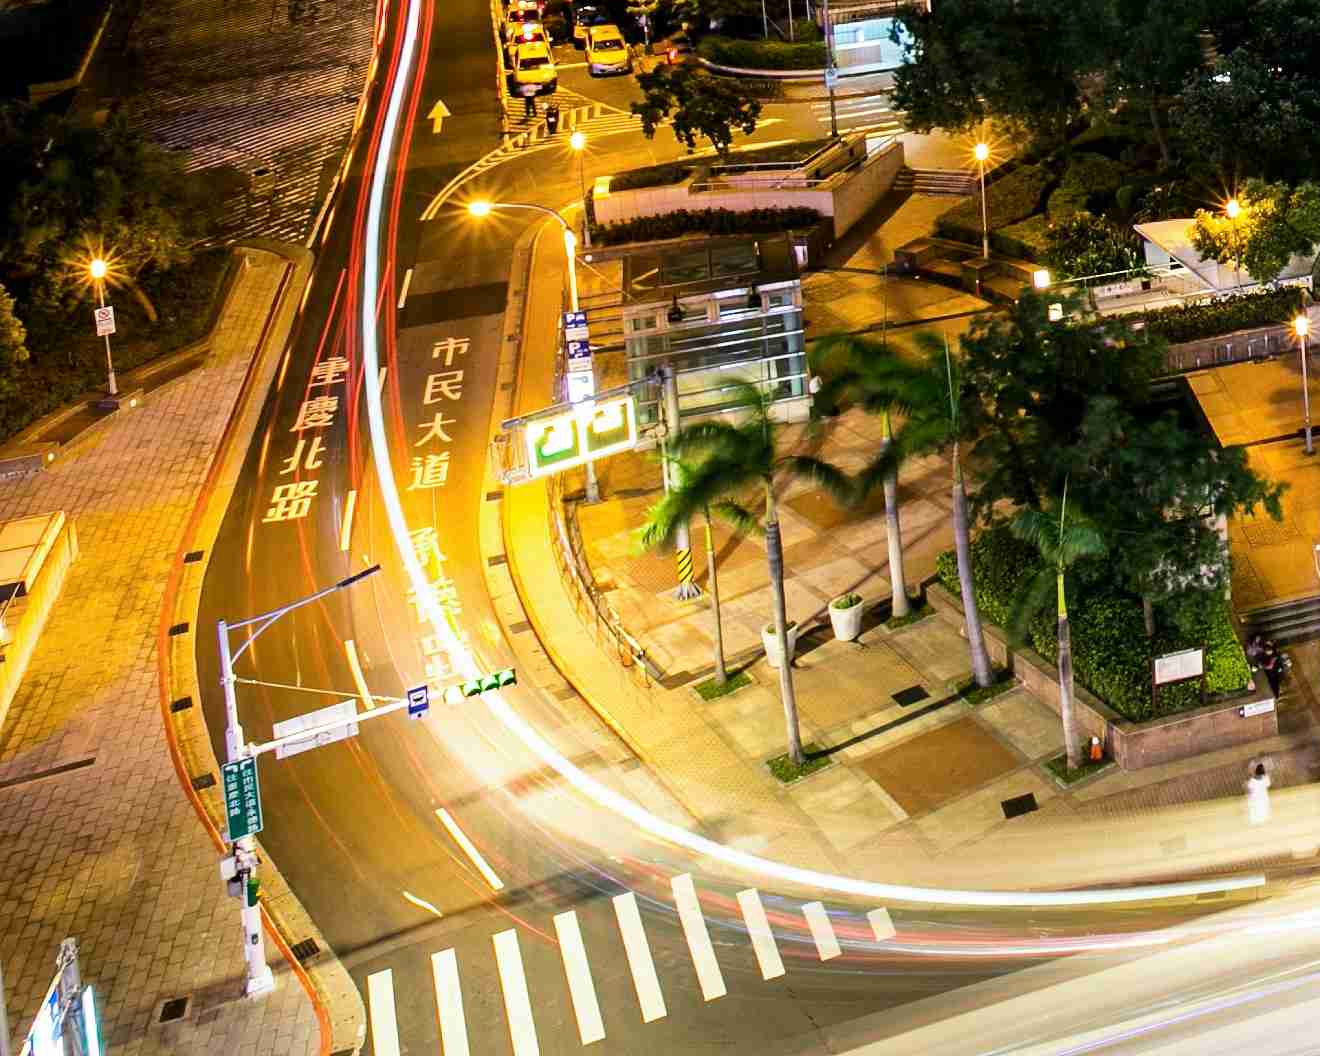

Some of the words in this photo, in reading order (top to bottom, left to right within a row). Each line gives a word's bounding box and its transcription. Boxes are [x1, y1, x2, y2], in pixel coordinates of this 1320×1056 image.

[262, 356, 350, 523] 重慶北路
[408, 337, 471, 491] 市民大道
